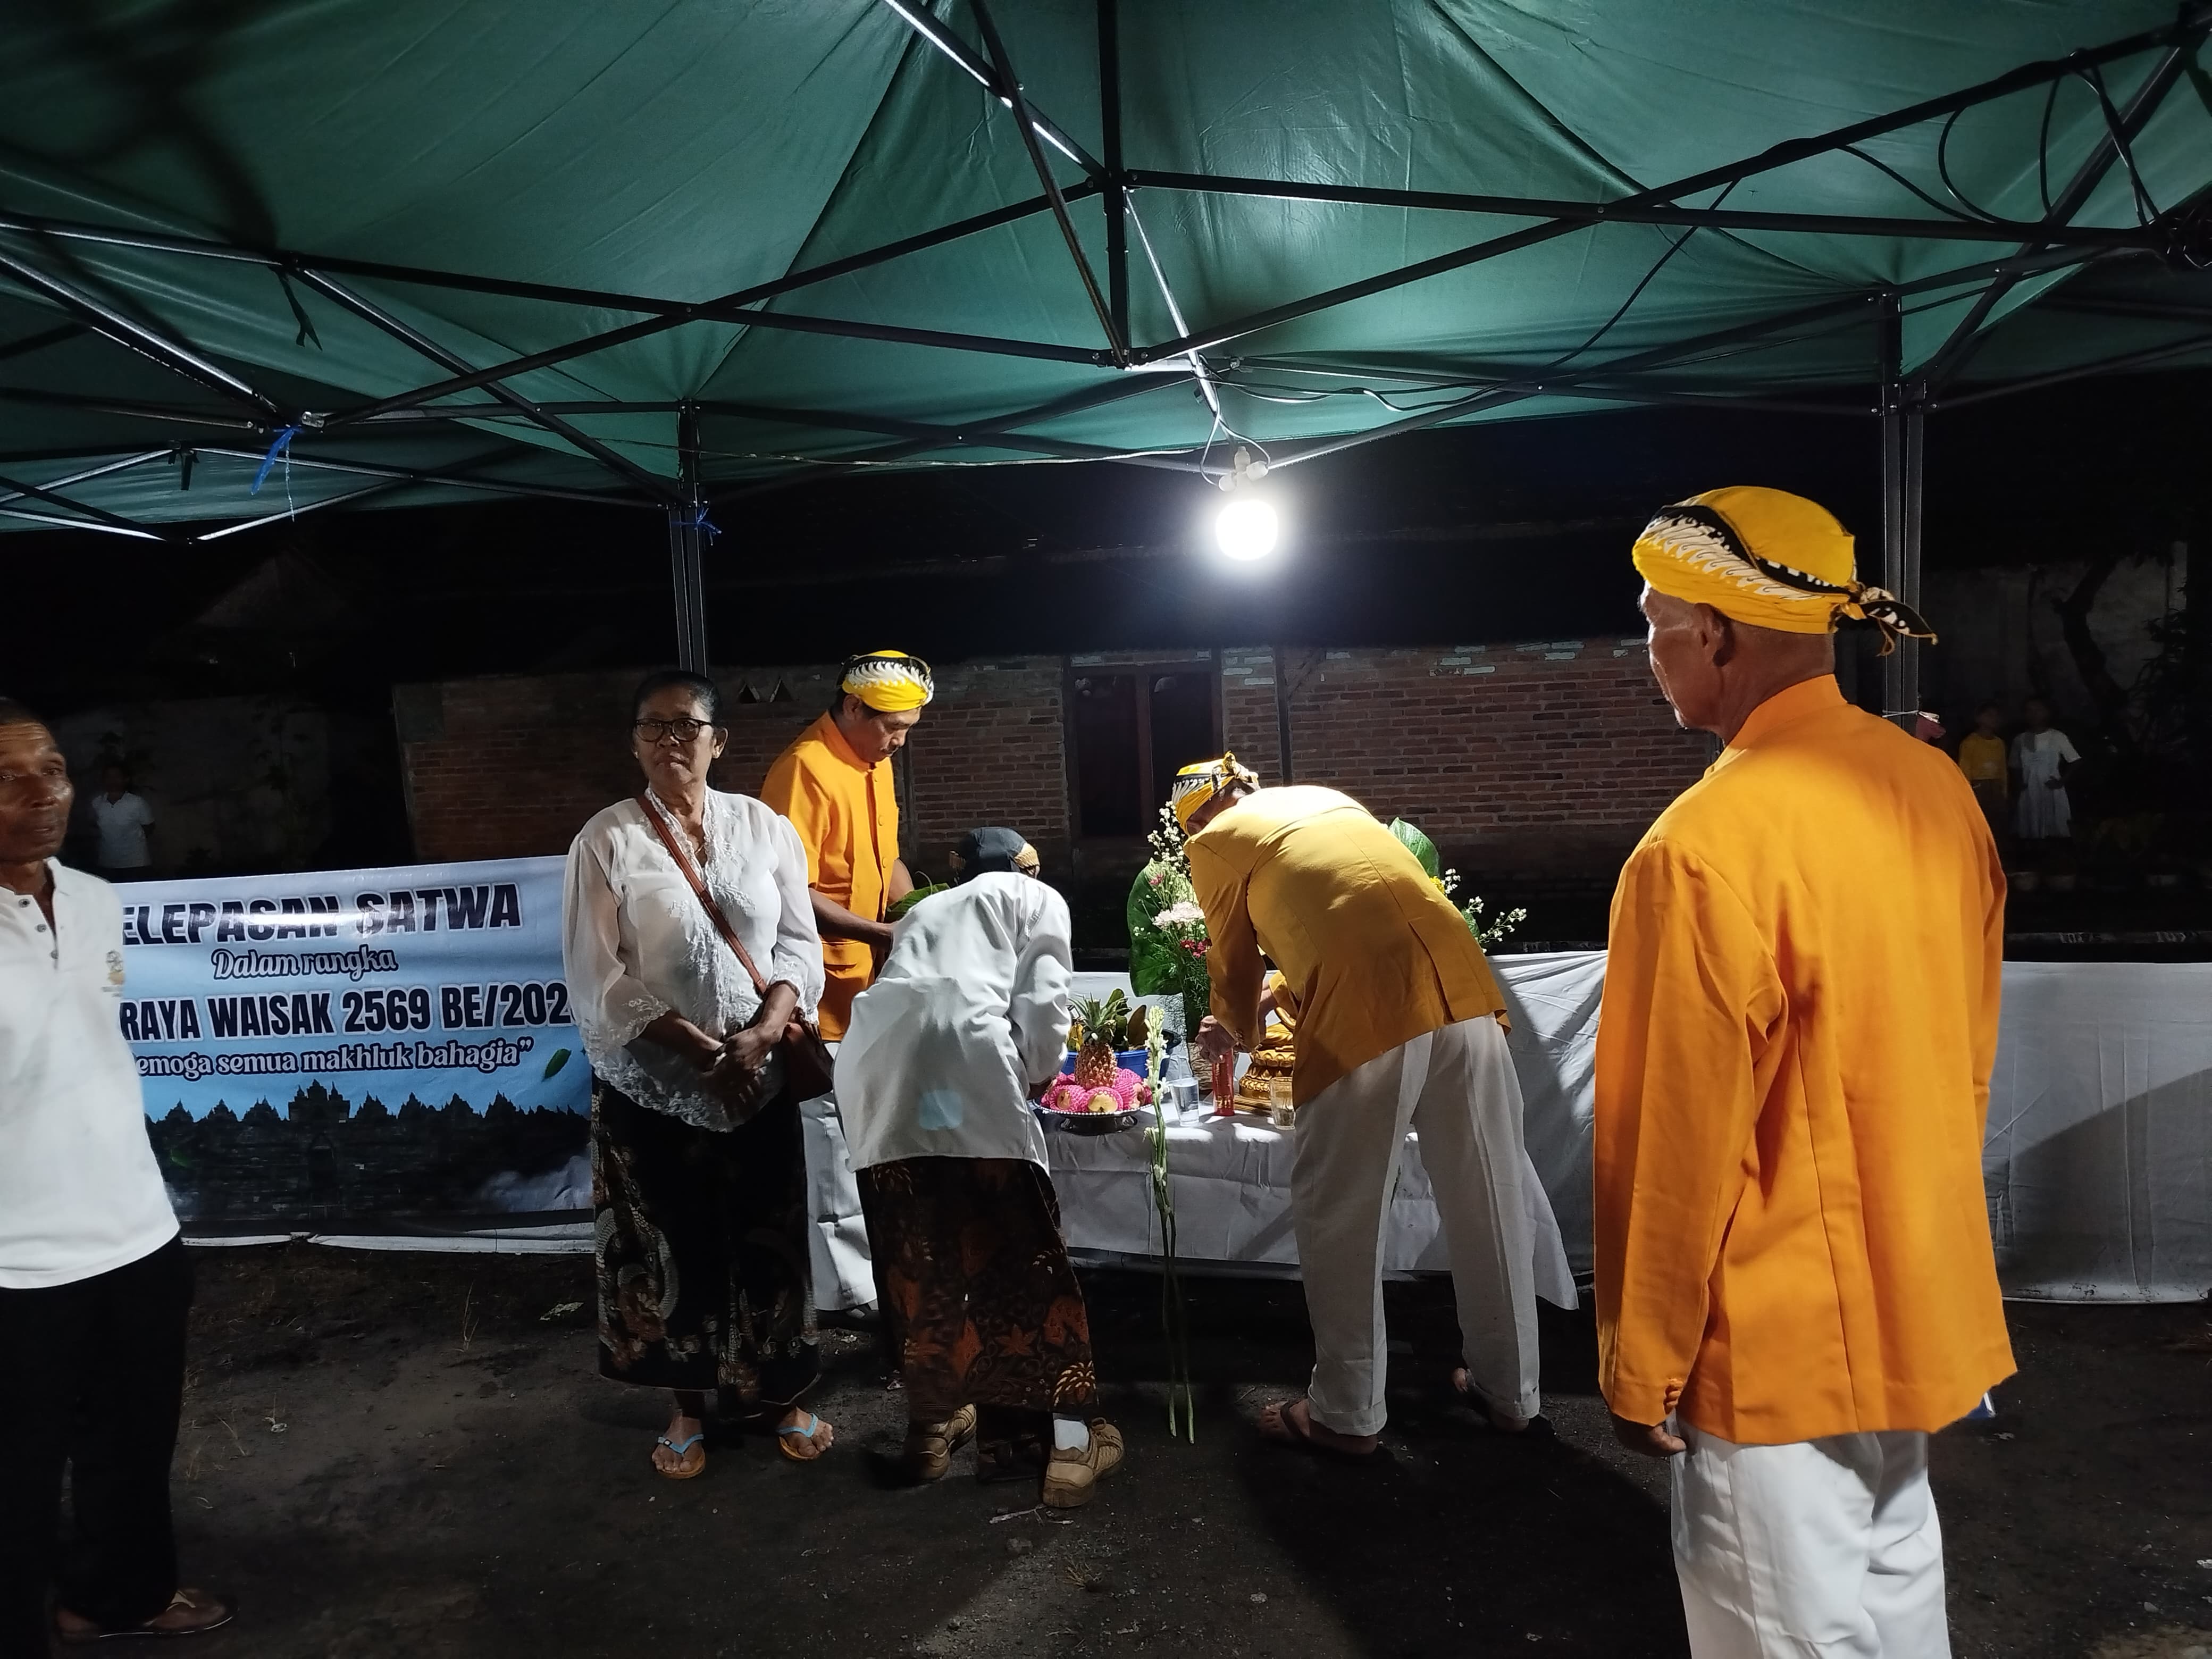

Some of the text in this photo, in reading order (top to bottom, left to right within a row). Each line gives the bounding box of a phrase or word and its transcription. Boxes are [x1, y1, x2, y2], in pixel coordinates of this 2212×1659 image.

[355, 883, 522, 936] SATWA
[212, 945, 398, 980] Dalam rangka
[120, 982, 576, 1041] RAYA WAISAK 2569 BE/202
[133, 1052, 213, 1080] emoga
[217, 1053, 297, 1073] semua
[302, 1043, 413, 1071] makhluk
